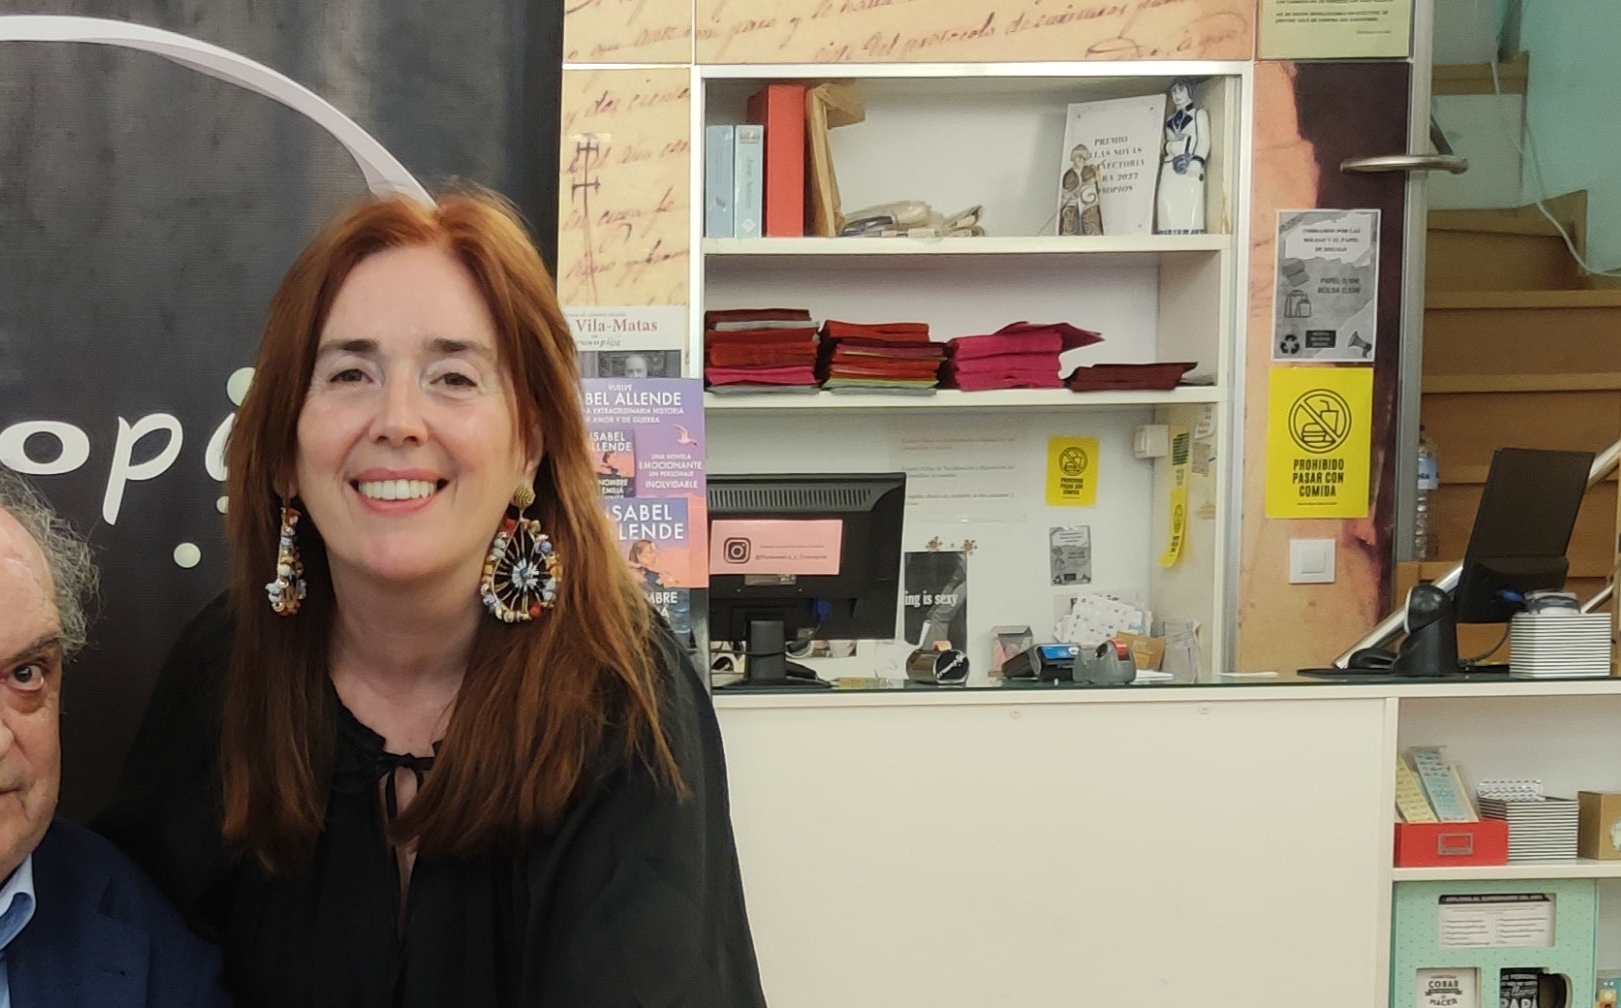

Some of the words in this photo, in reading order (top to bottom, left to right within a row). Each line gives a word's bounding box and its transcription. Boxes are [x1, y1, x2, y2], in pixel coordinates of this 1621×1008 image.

[576, 319, 658, 333] Vila-Matas
[585, 392, 610, 406] BEL
[614, 392, 682, 406] ALLENDE
[592, 441, 632, 452] LLENDE
[639, 461, 703, 470] EMOCIONANTE
[1293, 458, 1345, 471] PROHIBIDO
[645, 480, 698, 489] INOLVIDABLE
[1292, 472, 1323, 484] PASAR
[1325, 472, 1344, 484] CON
[1298, 485, 1337, 498] COMIDA
[618, 522, 685, 541] LENDE
[648, 591, 678, 604] MBRE
[904, 590, 921, 608] ing
[922, 589, 932, 605] is
[935, 593, 958, 607] sexy
